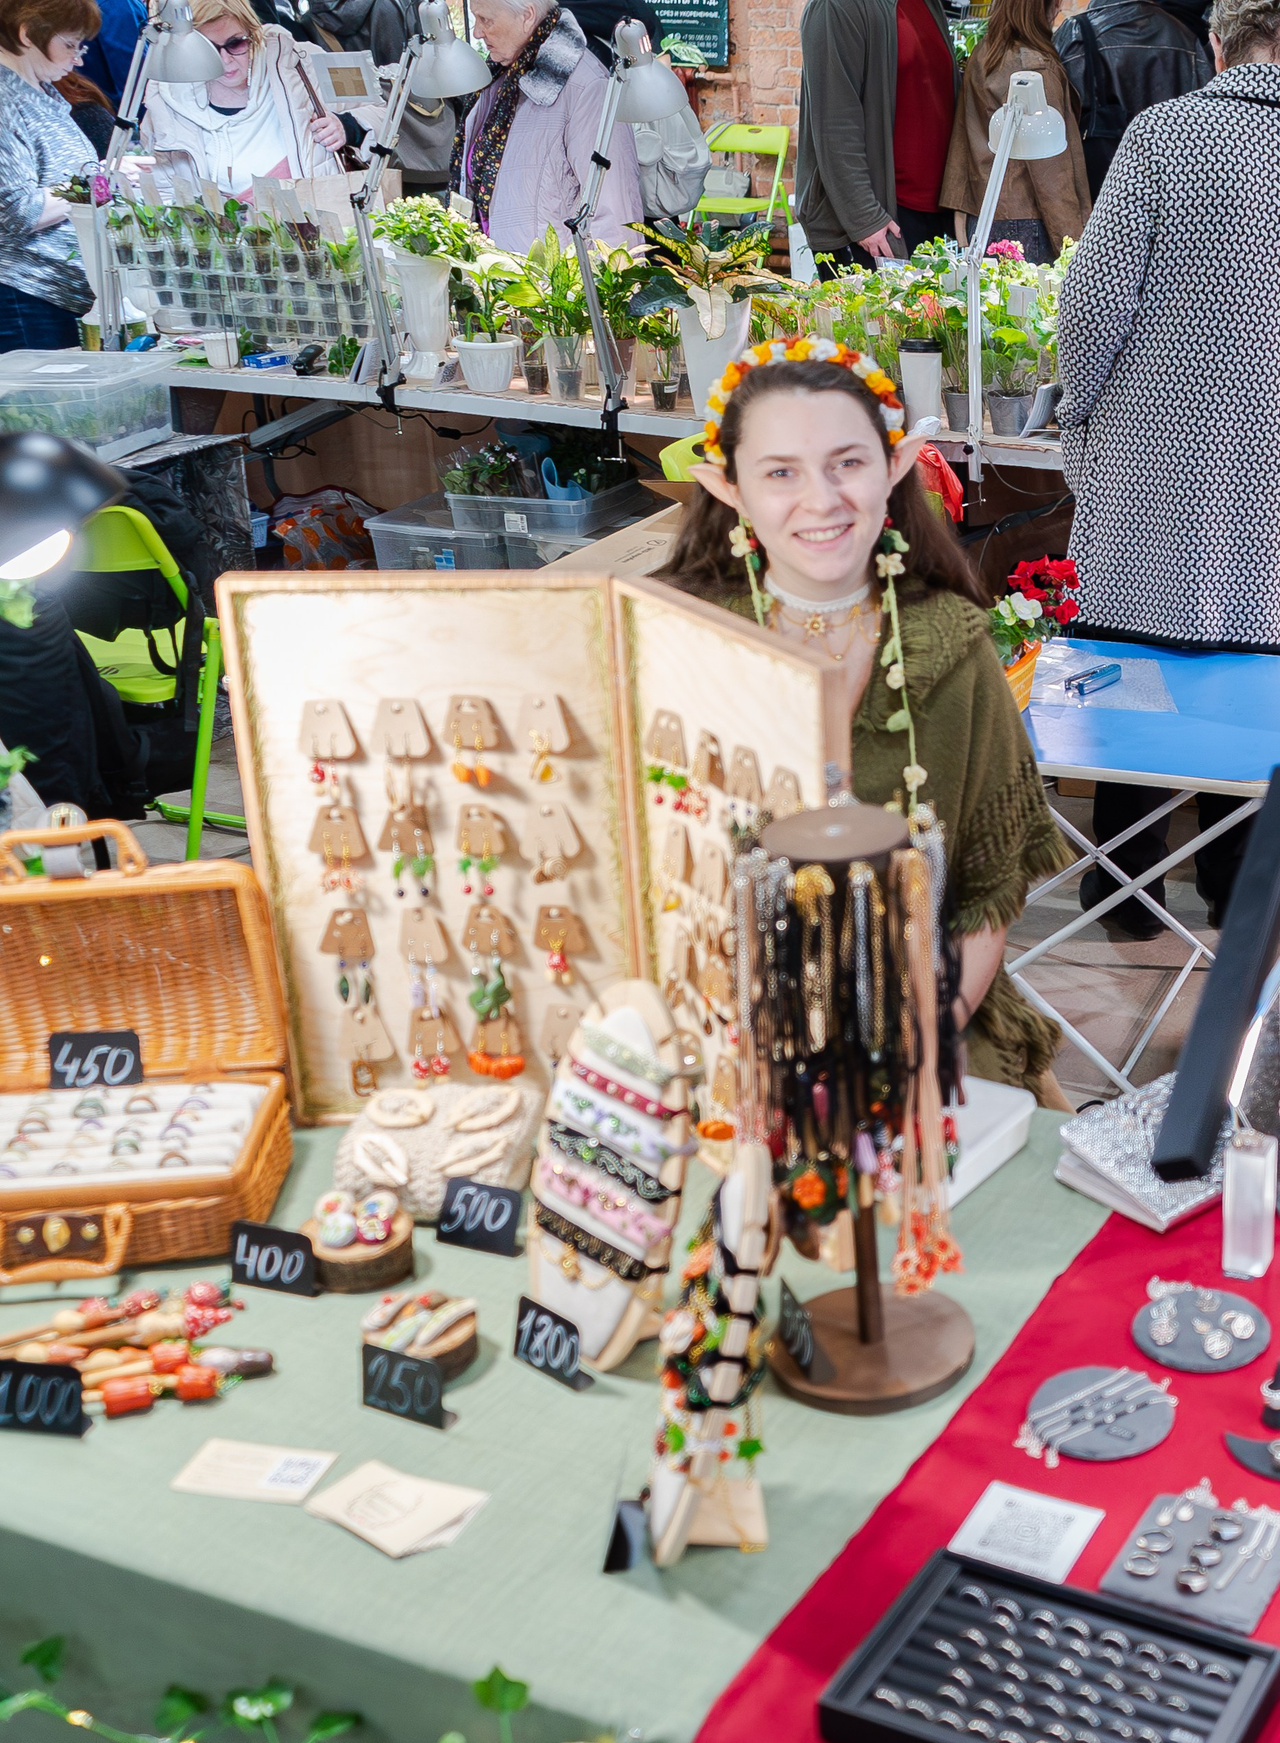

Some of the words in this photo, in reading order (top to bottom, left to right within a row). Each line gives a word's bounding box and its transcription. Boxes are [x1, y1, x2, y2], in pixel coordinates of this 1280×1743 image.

[54, 1041, 134, 1087] 450
[440, 1185, 513, 1233] 500
[235, 1233, 304, 1285] 400
[0, 1371, 82, 1426] 1000
[364, 1354, 440, 1415] 250
